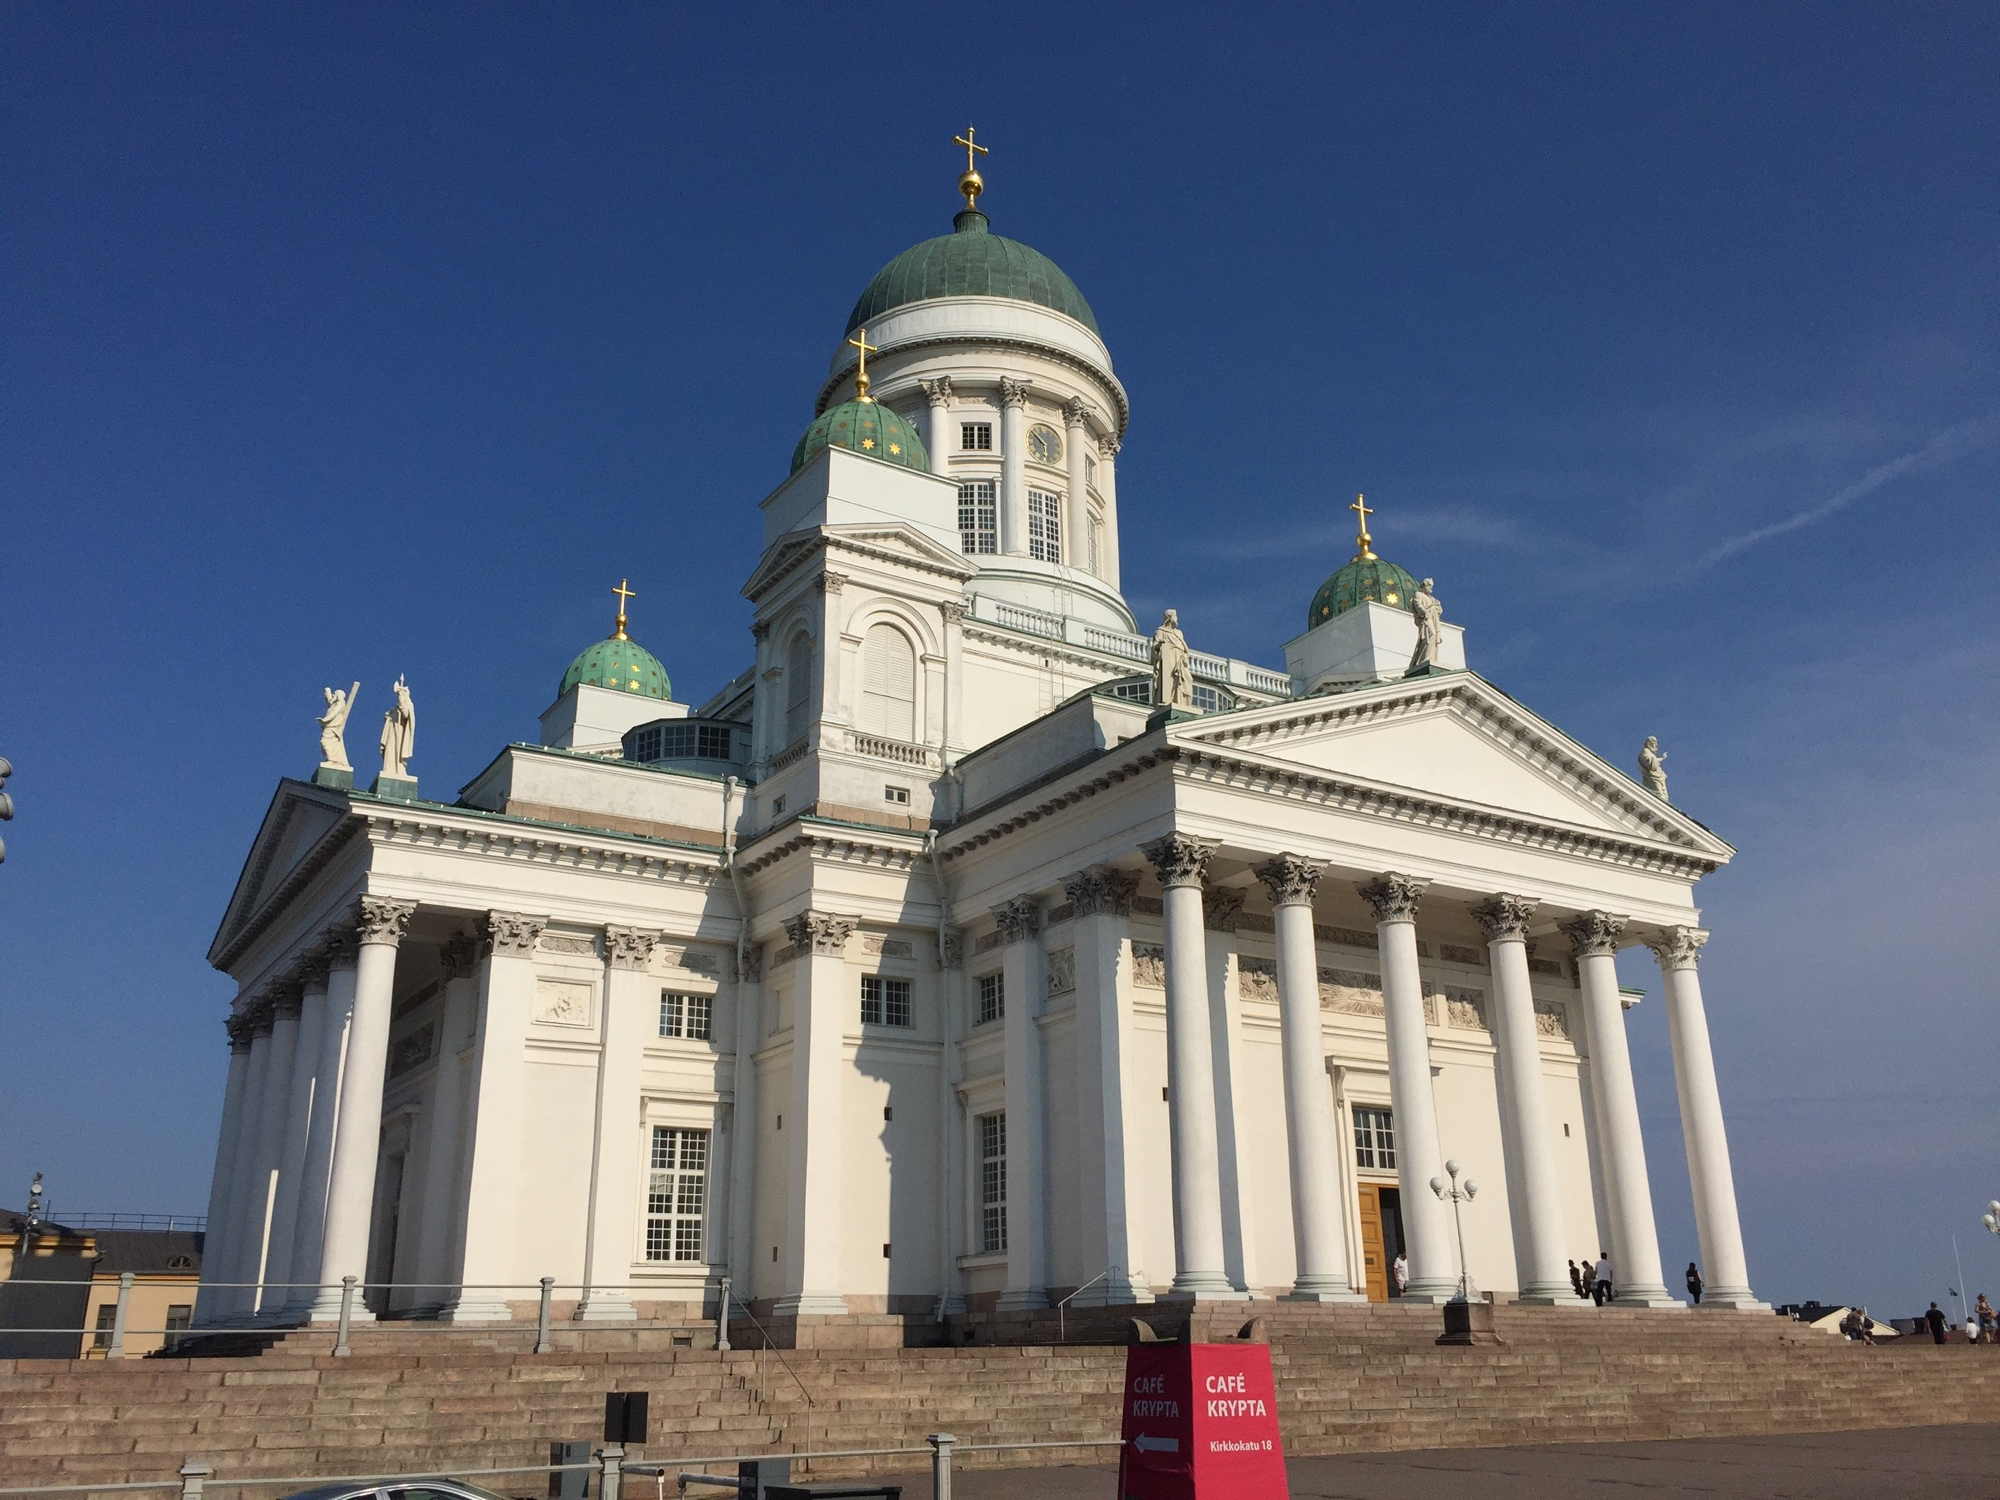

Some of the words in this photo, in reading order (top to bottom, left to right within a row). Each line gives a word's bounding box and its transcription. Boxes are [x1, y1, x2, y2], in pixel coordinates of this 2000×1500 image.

[1134, 1374, 1165, 1393] CAFÉ
[1206, 1373, 1246, 1393] CAFÉ
[1133, 1400, 1180, 1417] KRYPTA
[1207, 1400, 1267, 1417] KRYPTA
[1210, 1440, 1260, 1453] Kirkkokatu
[1262, 1440, 1273, 1451] 18
